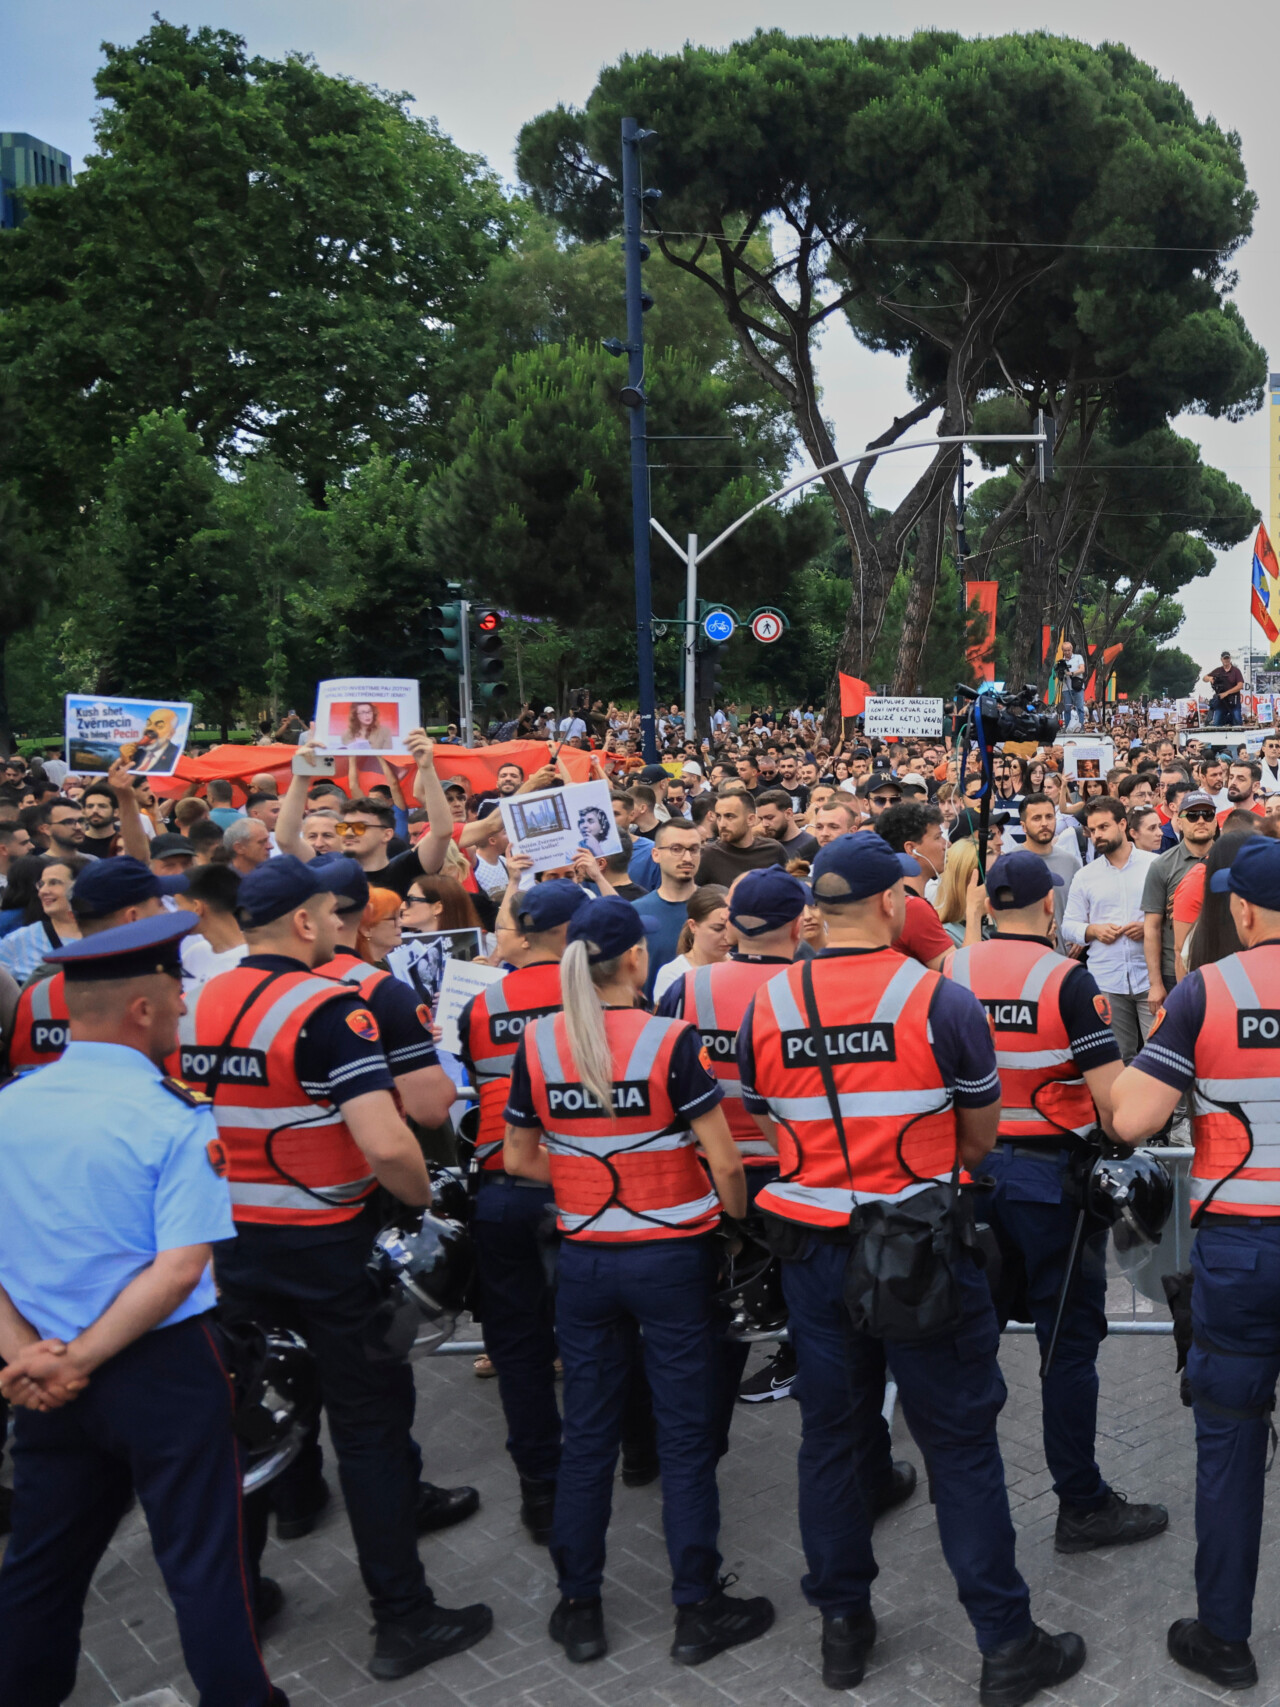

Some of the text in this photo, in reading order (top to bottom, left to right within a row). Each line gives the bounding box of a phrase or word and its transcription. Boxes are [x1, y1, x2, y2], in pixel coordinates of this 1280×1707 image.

[76, 707, 123, 717] Kush shet
[77, 718, 131, 729] Zvërnecin
[113, 729, 139, 738] Pecin
[786, 1030, 889, 1059] POLICIA
